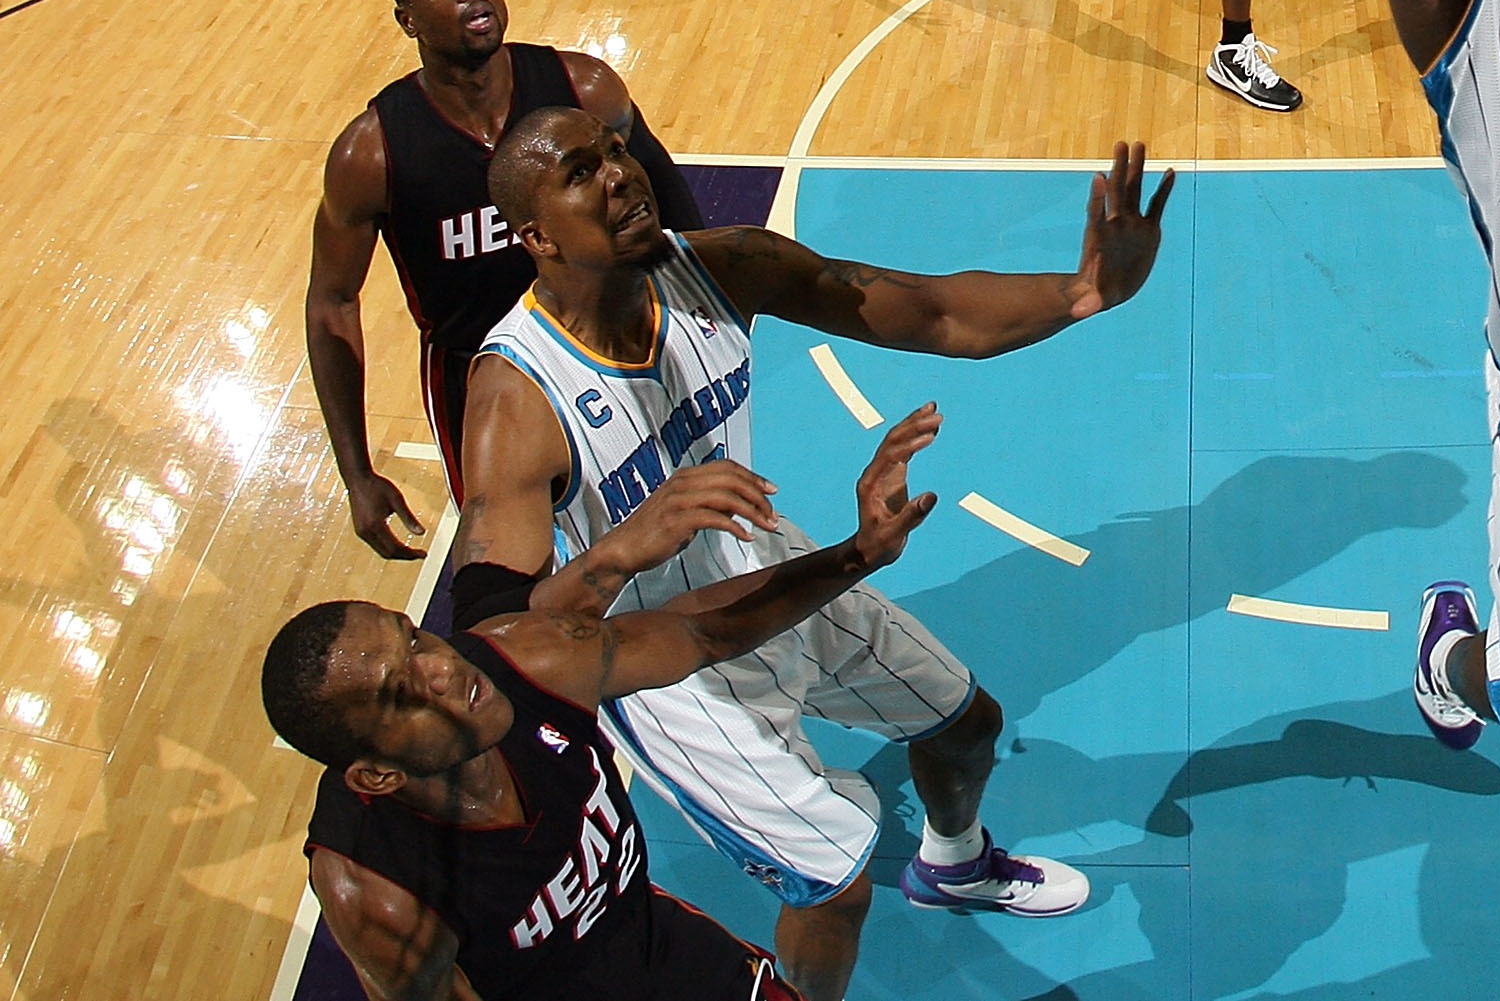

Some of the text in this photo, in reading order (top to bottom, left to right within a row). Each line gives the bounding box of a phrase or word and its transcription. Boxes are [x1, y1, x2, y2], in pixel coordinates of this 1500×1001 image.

[440, 205, 521, 261] HE
[575, 388, 613, 429] C
[598, 434, 667, 525] NEW
[509, 745, 621, 950] HEAT
[574, 822, 642, 942] 22
